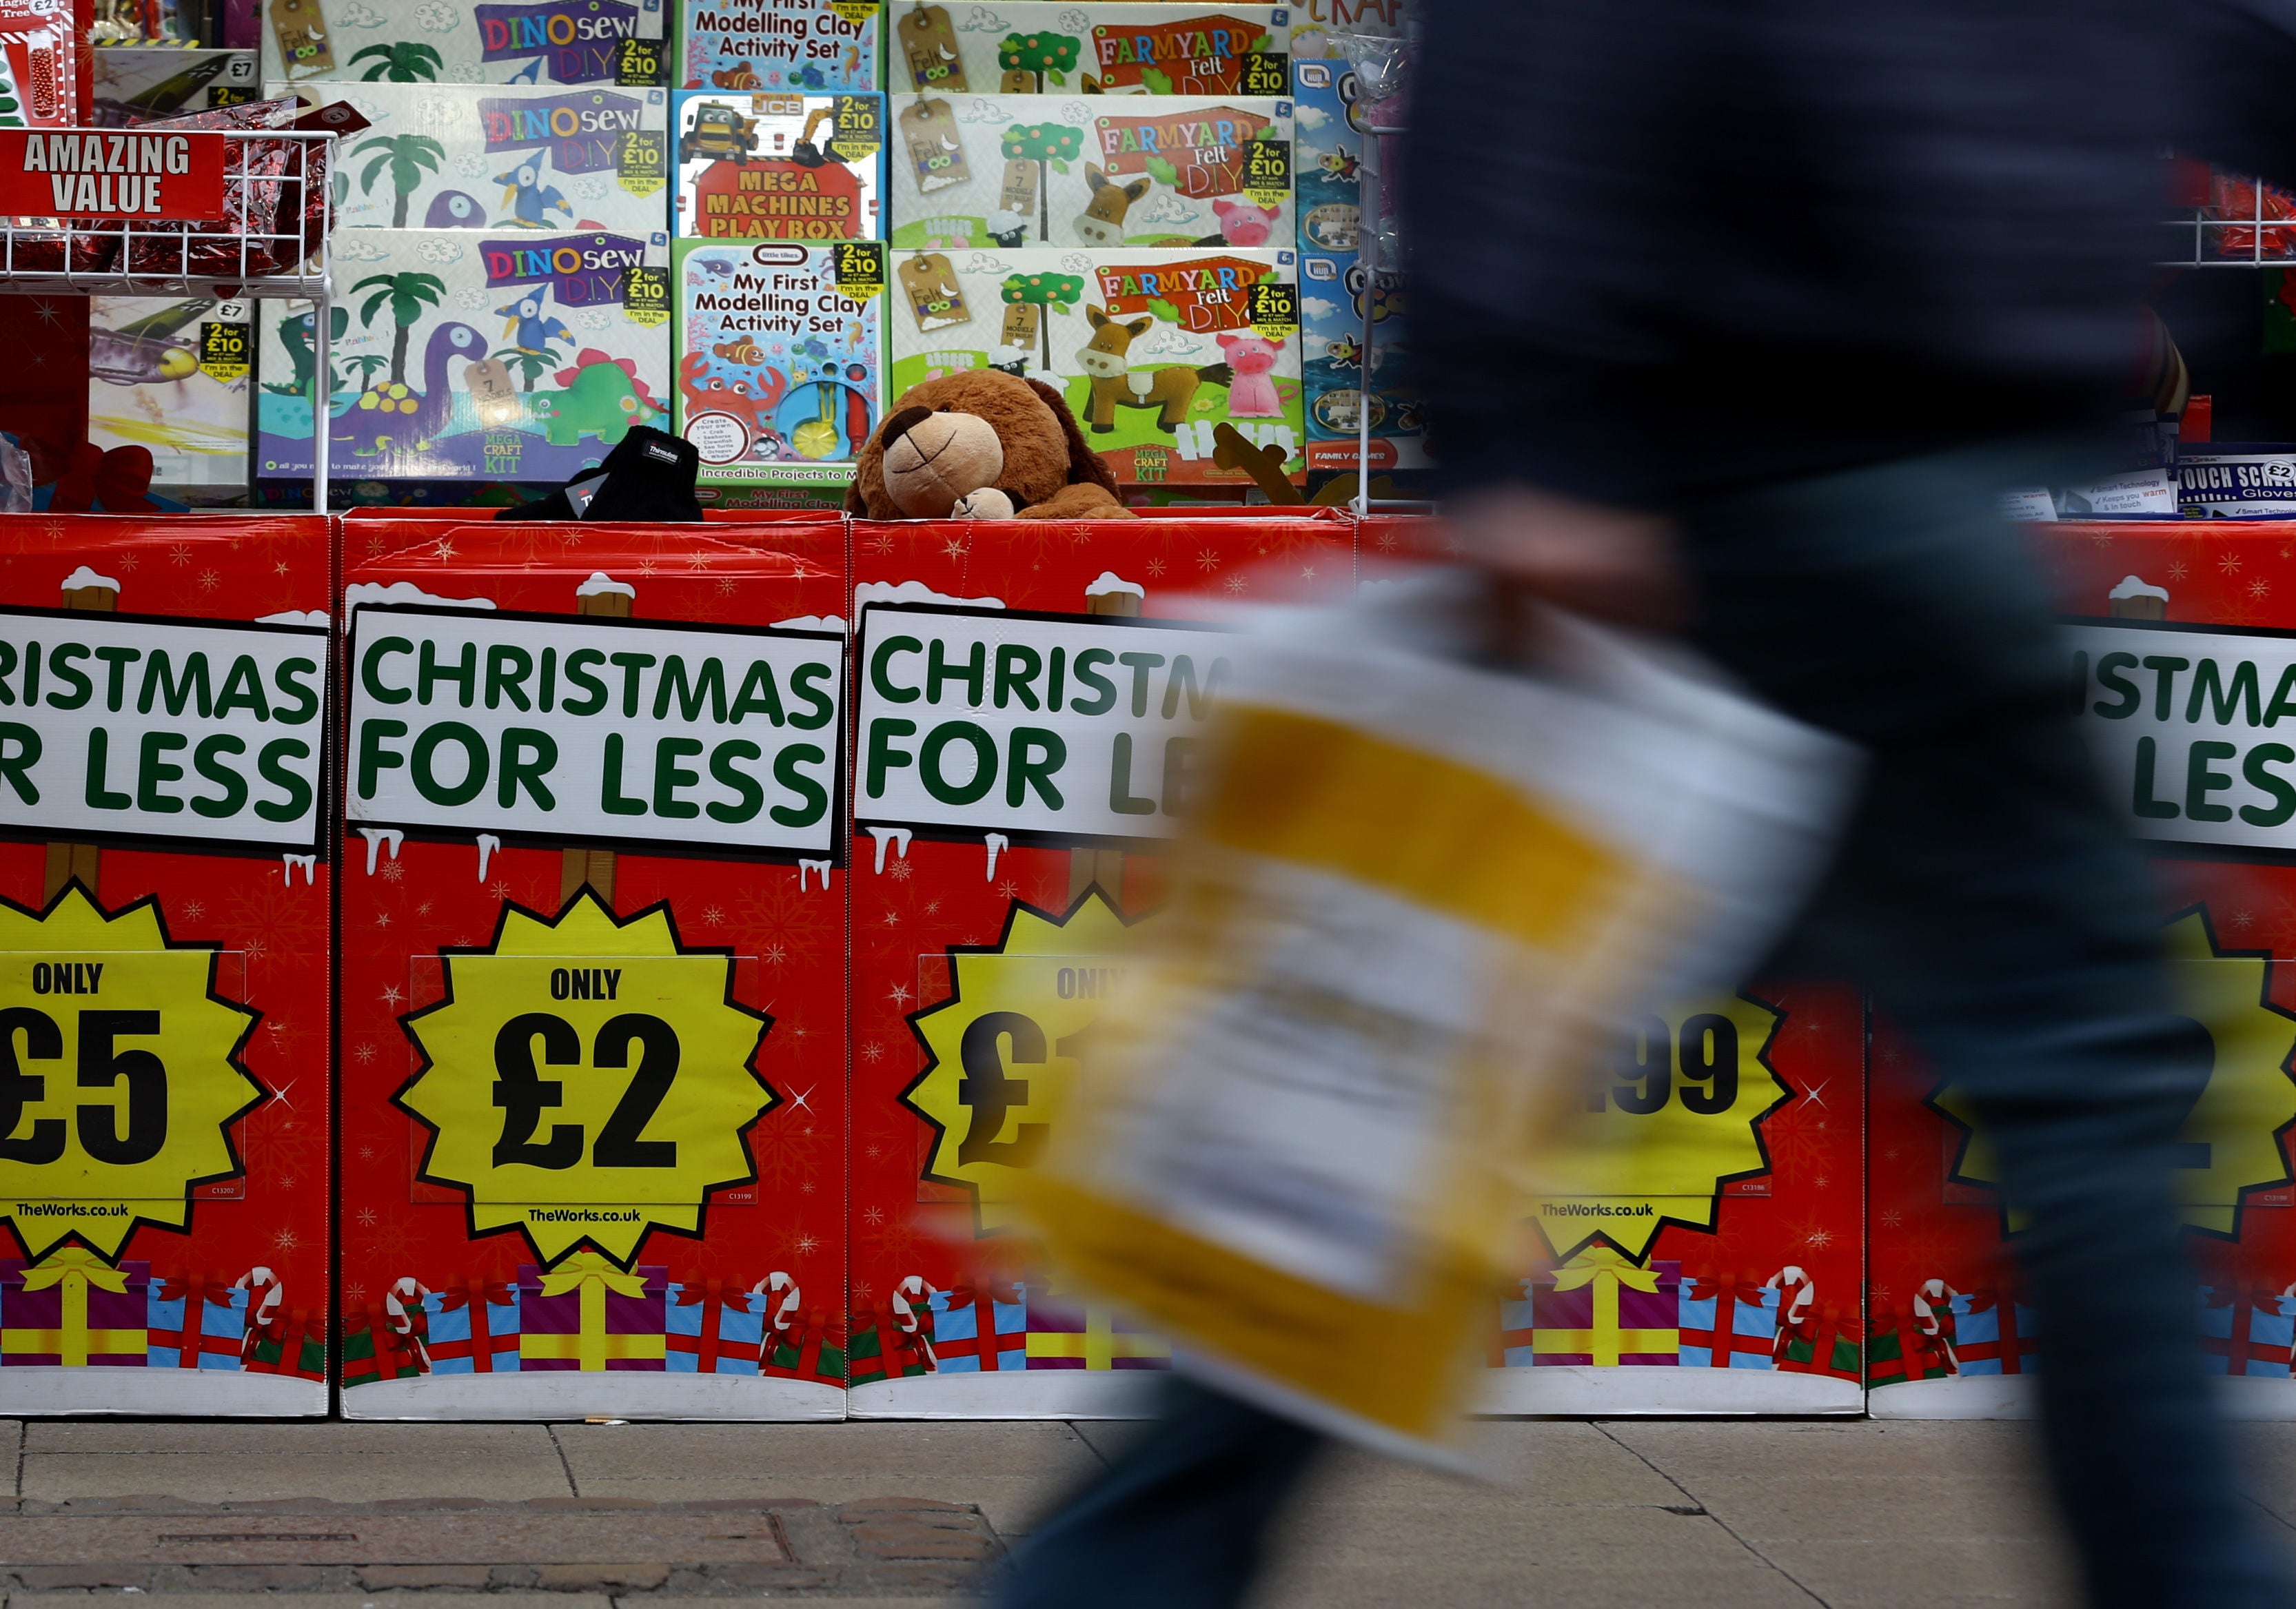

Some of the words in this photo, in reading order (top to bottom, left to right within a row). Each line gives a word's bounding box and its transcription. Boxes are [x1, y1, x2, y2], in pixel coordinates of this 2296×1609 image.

[34, 0, 53, 10] £2
[733, 0, 764, 12] My
[1, 10, 30, 18] Tree
[695, 11, 807, 39] Modelling
[815, 14, 865, 41] Clay
[624, 39, 636, 56] 2
[638, 45, 652, 55] for
[719, 37, 800, 63] Activity
[806, 39, 840, 59] Set
[1099, 28, 1250, 65] FARMYARD
[621, 57, 657, 74] £10
[910, 49, 942, 71] Felt
[1190, 56, 1224, 77] Felt
[1251, 54, 1262, 72] 2
[1263, 60, 1278, 69] for
[232, 62, 252, 76] £7
[1247, 72, 1283, 89] £10
[216, 88, 229, 104] 2
[230, 94, 245, 103] for
[841, 96, 854, 112] 2
[855, 101, 870, 110] for
[753, 101, 802, 114] JCB
[837, 113, 874, 130] £10
[626, 132, 638, 148] 2
[639, 138, 653, 146] for
[1103, 120, 1254, 154] FARMYARD
[23, 134, 190, 174] AMAZING
[623, 148, 658, 165] £10
[912, 139, 942, 161] Felt
[1194, 145, 1229, 166] Felt
[1252, 141, 1264, 158] 2
[1266, 147, 1280, 156] for
[1249, 159, 1285, 176] £10
[739, 171, 818, 192] MEGA
[1015, 176, 1024, 187] 7
[51, 174, 162, 213] VALUE
[706, 194, 851, 216] MACHINES
[709, 218, 781, 238] PLAY
[787, 220, 846, 239] BOX
[842, 244, 855, 259] 2
[856, 249, 871, 257] for
[840, 258, 877, 273] £10
[1313, 267, 1329, 276] HUB
[630, 268, 643, 283] 2
[644, 274, 658, 282] for
[1103, 267, 1256, 298] FARMYARD
[628, 283, 664, 298] £10
[733, 274, 766, 294] My
[773, 274, 819, 291] First
[911, 287, 942, 305] Felt
[1196, 288, 1232, 305] Felt
[1257, 285, 1270, 300] 2
[1271, 290, 1286, 298] for
[220, 304, 243, 317] £7
[695, 294, 809, 317] Modelling
[817, 296, 868, 317] Clay
[1255, 300, 1291, 314] £10
[210, 322, 222, 337] 2
[223, 327, 238, 336] for
[720, 314, 802, 336] Activity
[809, 316, 844, 332] Set
[1016, 317, 1024, 326] 7
[206, 338, 243, 352] £10
[484, 380, 493, 392] 7
[485, 434, 522, 444] MEGA
[484, 444, 522, 455] CRAFT
[1135, 450, 1167, 459] MEGA
[1315, 452, 1350, 460] FAMILY
[1352, 452, 1385, 460] GMES
[292, 463, 307, 471] you
[332, 462, 341, 470] to
[343, 462, 367, 471] make
[485, 455, 520, 474] KIT
[1134, 458, 1168, 467] CRAFT
[701, 469, 767, 479] Incredible
[771, 469, 824, 481] Projects
[829, 471, 841, 480] to
[1135, 467, 1167, 482] KIT
[2178, 467, 2233, 490] TOUCH
[2268, 465, 2290, 478] £2
[751, 490, 774, 498] My
[778, 490, 809, 498] First
[2096, 483, 2118, 493] Smart
[2120, 479, 2160, 491] Technology
[726, 499, 802, 509] Modelling
[805, 500, 840, 509] Clay
[2102, 495, 2125, 504] Keeps
[2126, 493, 2140, 501] you
[2142, 489, 2166, 498] warm
[2120, 500, 2142, 509] touch
[360, 635, 834, 730] CHRISTMAS
[870, 635, 1234, 722] CHRISTM
[85, 726, 313, 823] LESS
[357, 718, 559, 812] FOR
[600, 732, 829, 828] LESS
[866, 717, 1067, 811] FOR
[1108, 732, 1206, 818] LE
[32, 962, 104, 995] ONLY
[550, 967, 622, 1001] ONLY
[0, 1006, 168, 1166] £5
[491, 1012, 681, 1171] £2
[16, 1202, 129, 1218] TheWorks.co.uk
[528, 1209, 641, 1223] TheWorks.co.uk
[1541, 1203, 1654, 1218] TheWorks.co.uk
